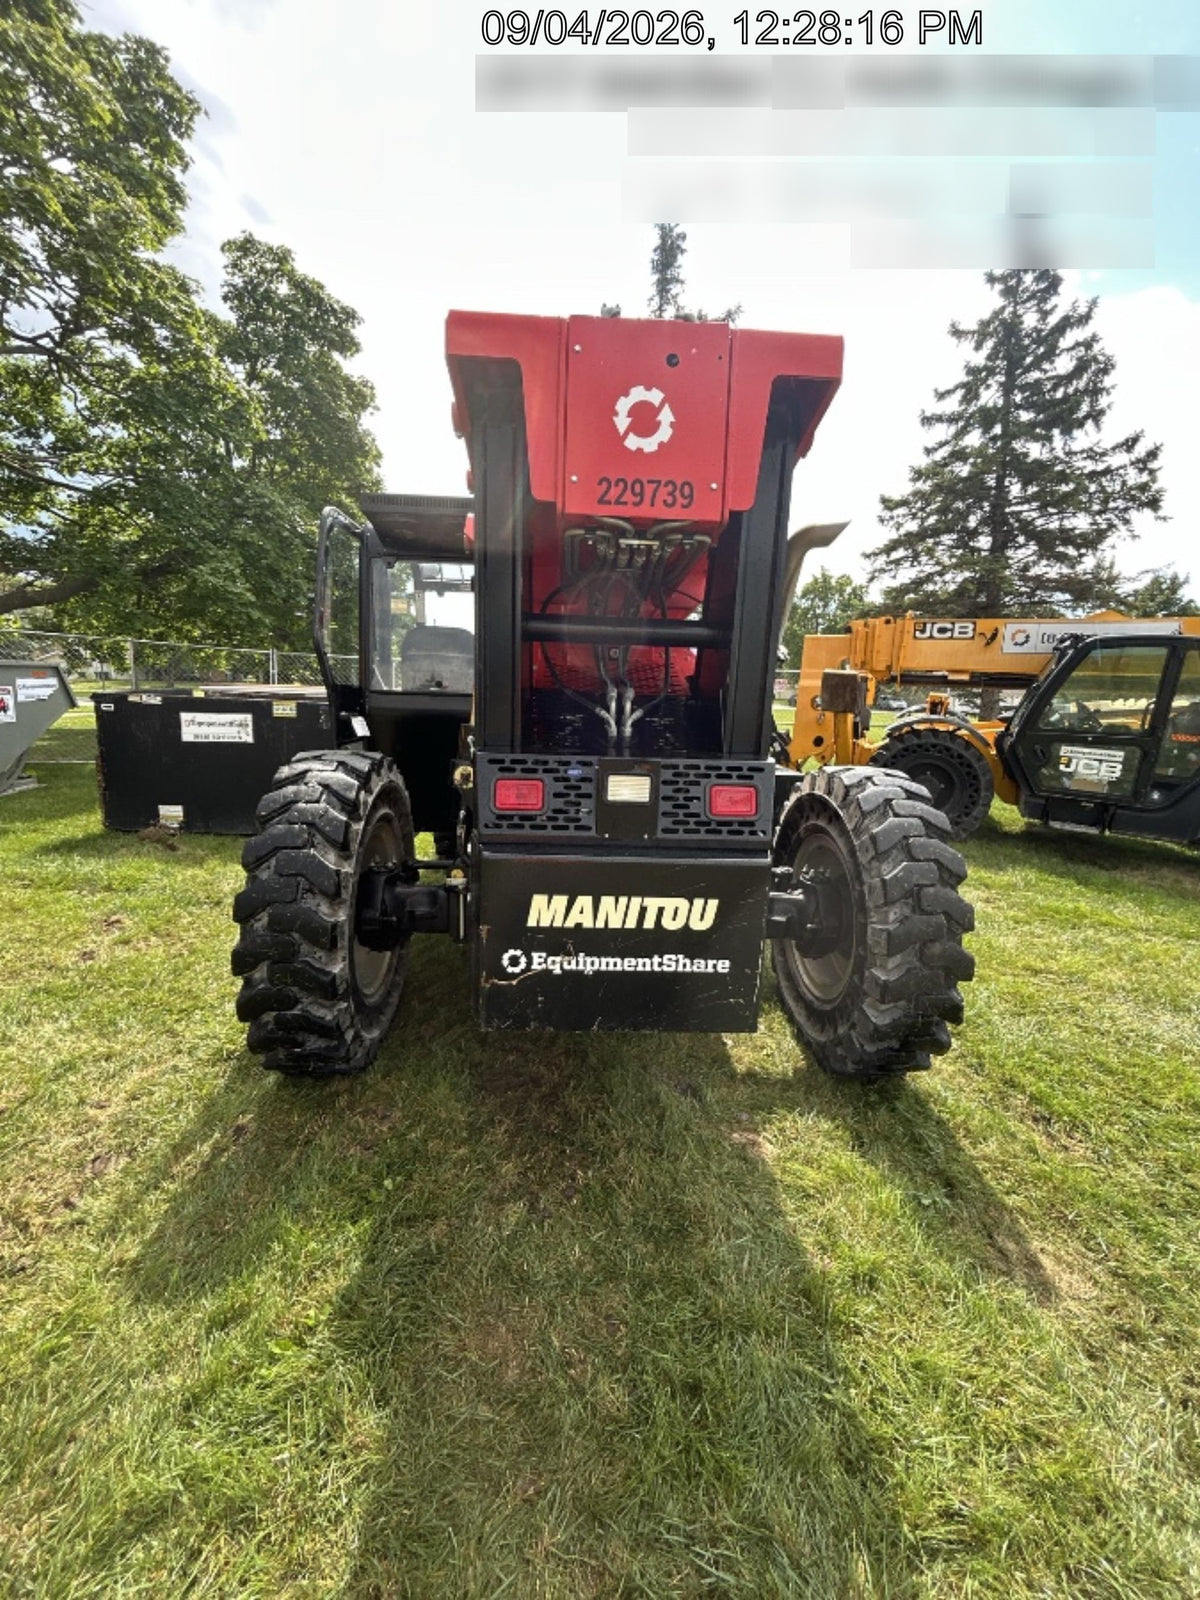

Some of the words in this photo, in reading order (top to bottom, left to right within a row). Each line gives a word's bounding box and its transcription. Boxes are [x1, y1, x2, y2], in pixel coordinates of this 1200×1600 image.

[596, 477, 695, 509] 229739
[915, 622, 974, 639] JCB
[1059, 756, 1122, 777] JCB
[526, 893, 719, 931] MANITOU
[531, 952, 731, 975] EquipmentShare
